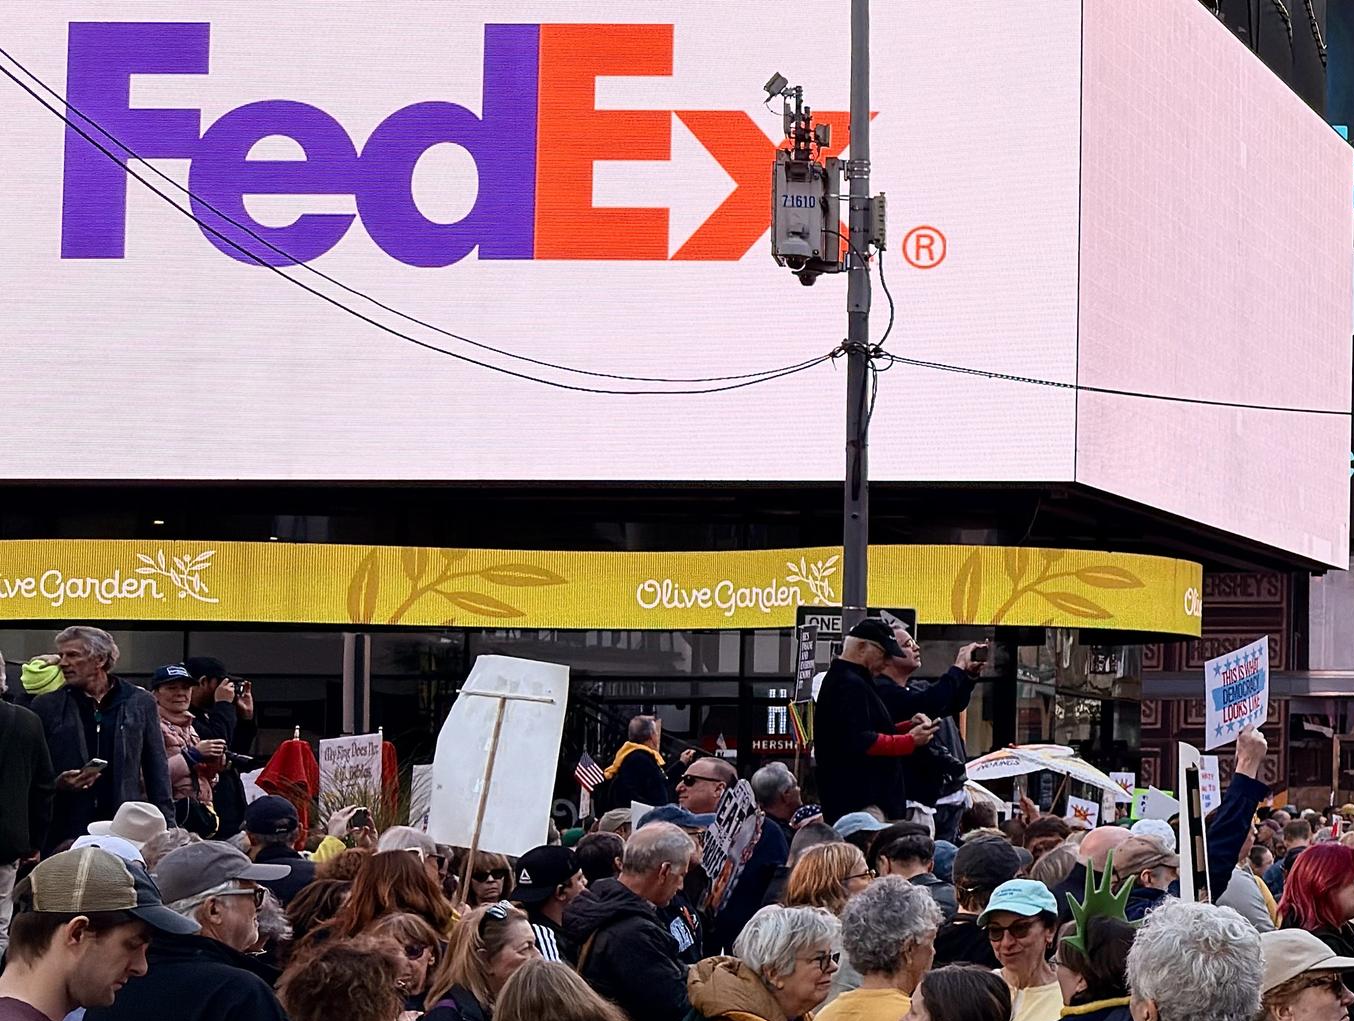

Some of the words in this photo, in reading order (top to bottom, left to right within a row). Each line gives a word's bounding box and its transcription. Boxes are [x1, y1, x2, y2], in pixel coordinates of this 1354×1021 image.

[61, 21, 878, 268] FedEx
[782, 194, 816, 209] 71610
[40, 569, 164, 607] Garden
[637, 579, 712, 609] Olive
[714, 579, 806, 617] Garden
[1222, 667, 1237, 687] THIS
[1238, 665, 1245, 680] IS
[1244, 657, 1259, 679] WHAT
[1222, 674, 1260, 705] DEMOCRACY
[1223, 698, 1248, 723] LOOKS
